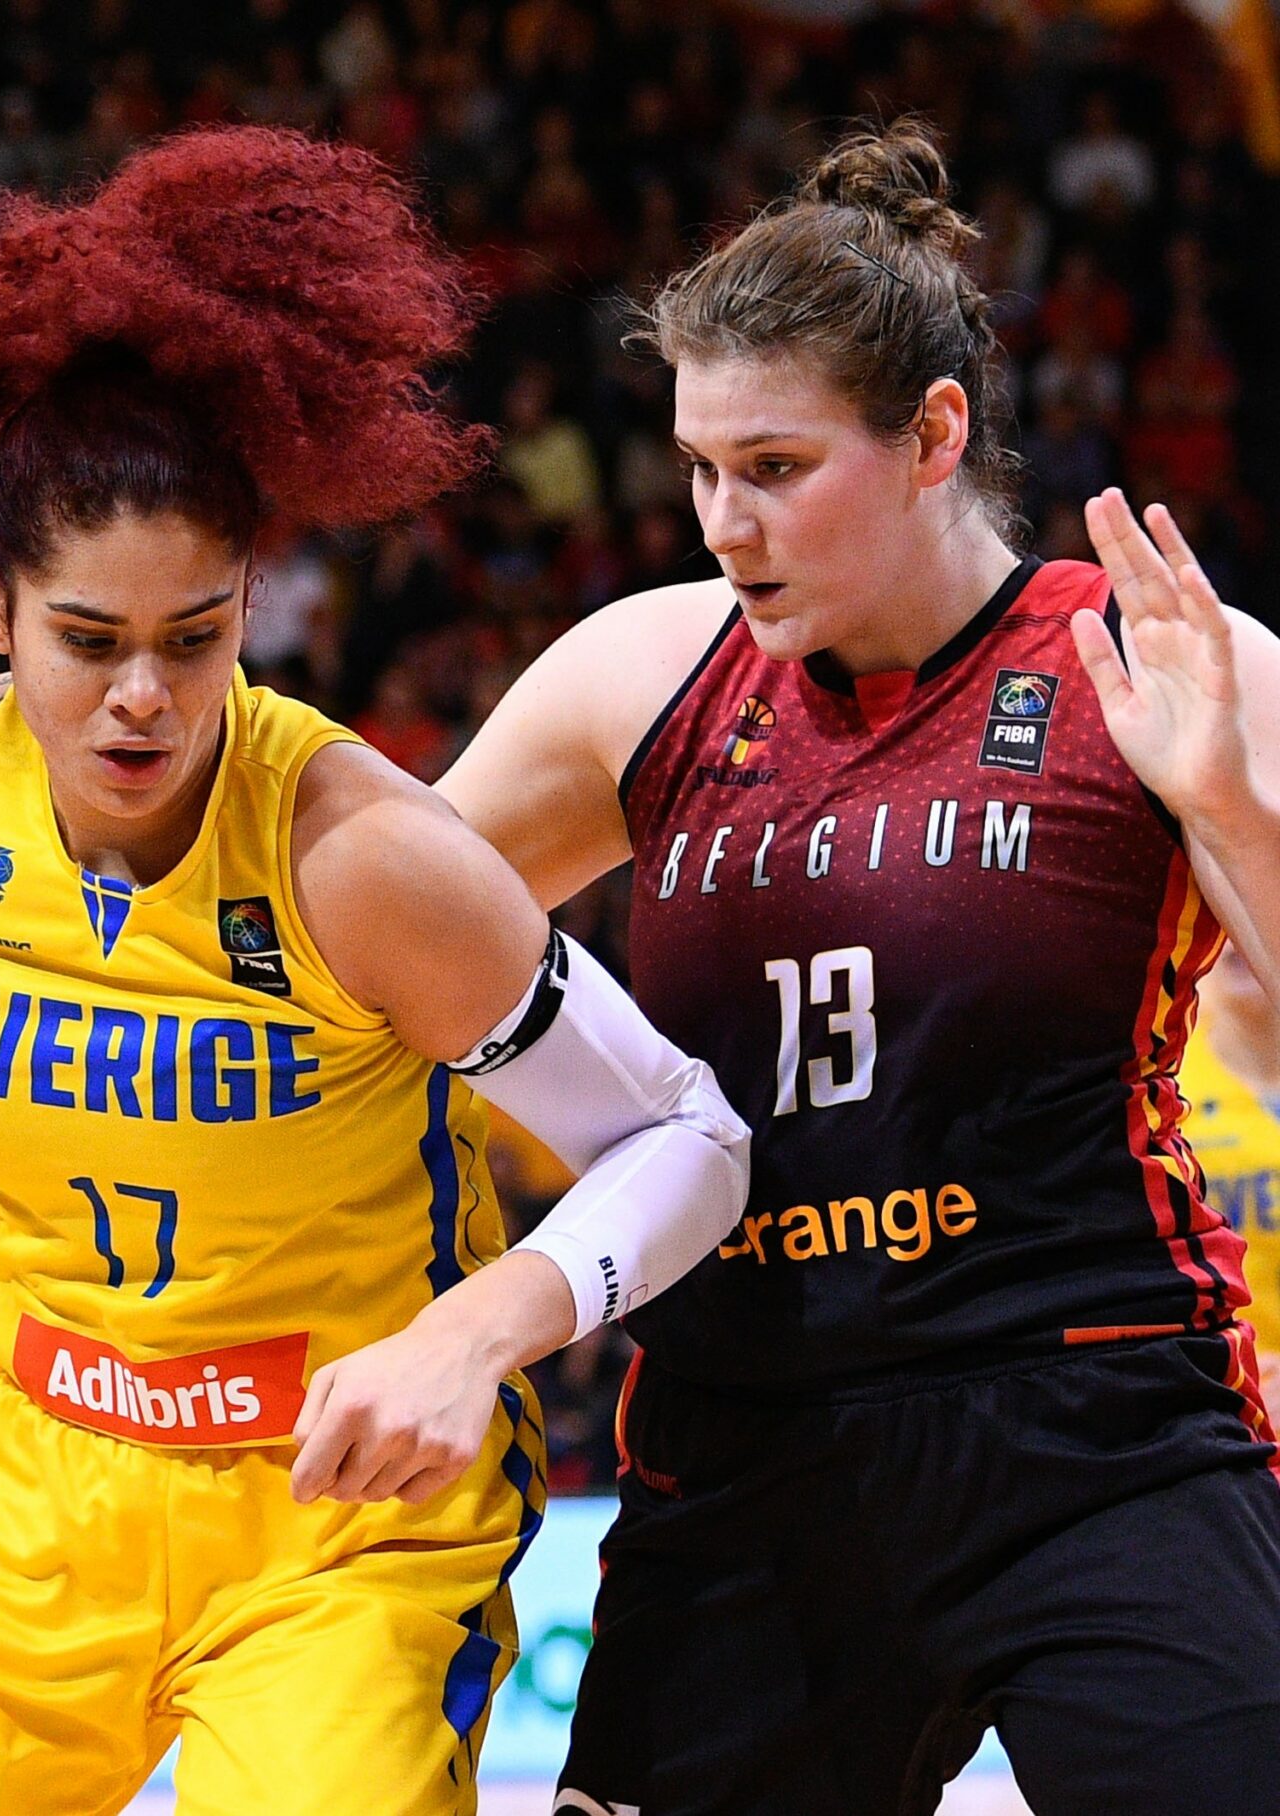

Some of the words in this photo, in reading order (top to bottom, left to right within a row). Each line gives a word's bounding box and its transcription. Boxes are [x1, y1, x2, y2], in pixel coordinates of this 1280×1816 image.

[993, 724, 1037, 744] FIBA
[657, 799, 1033, 901] BELGIUM
[763, 945, 878, 1118] 13
[67, 1176, 179, 1299] 17
[598, 1255, 619, 1325] BLIND
[46, 1347, 261, 1430] Adlibris
